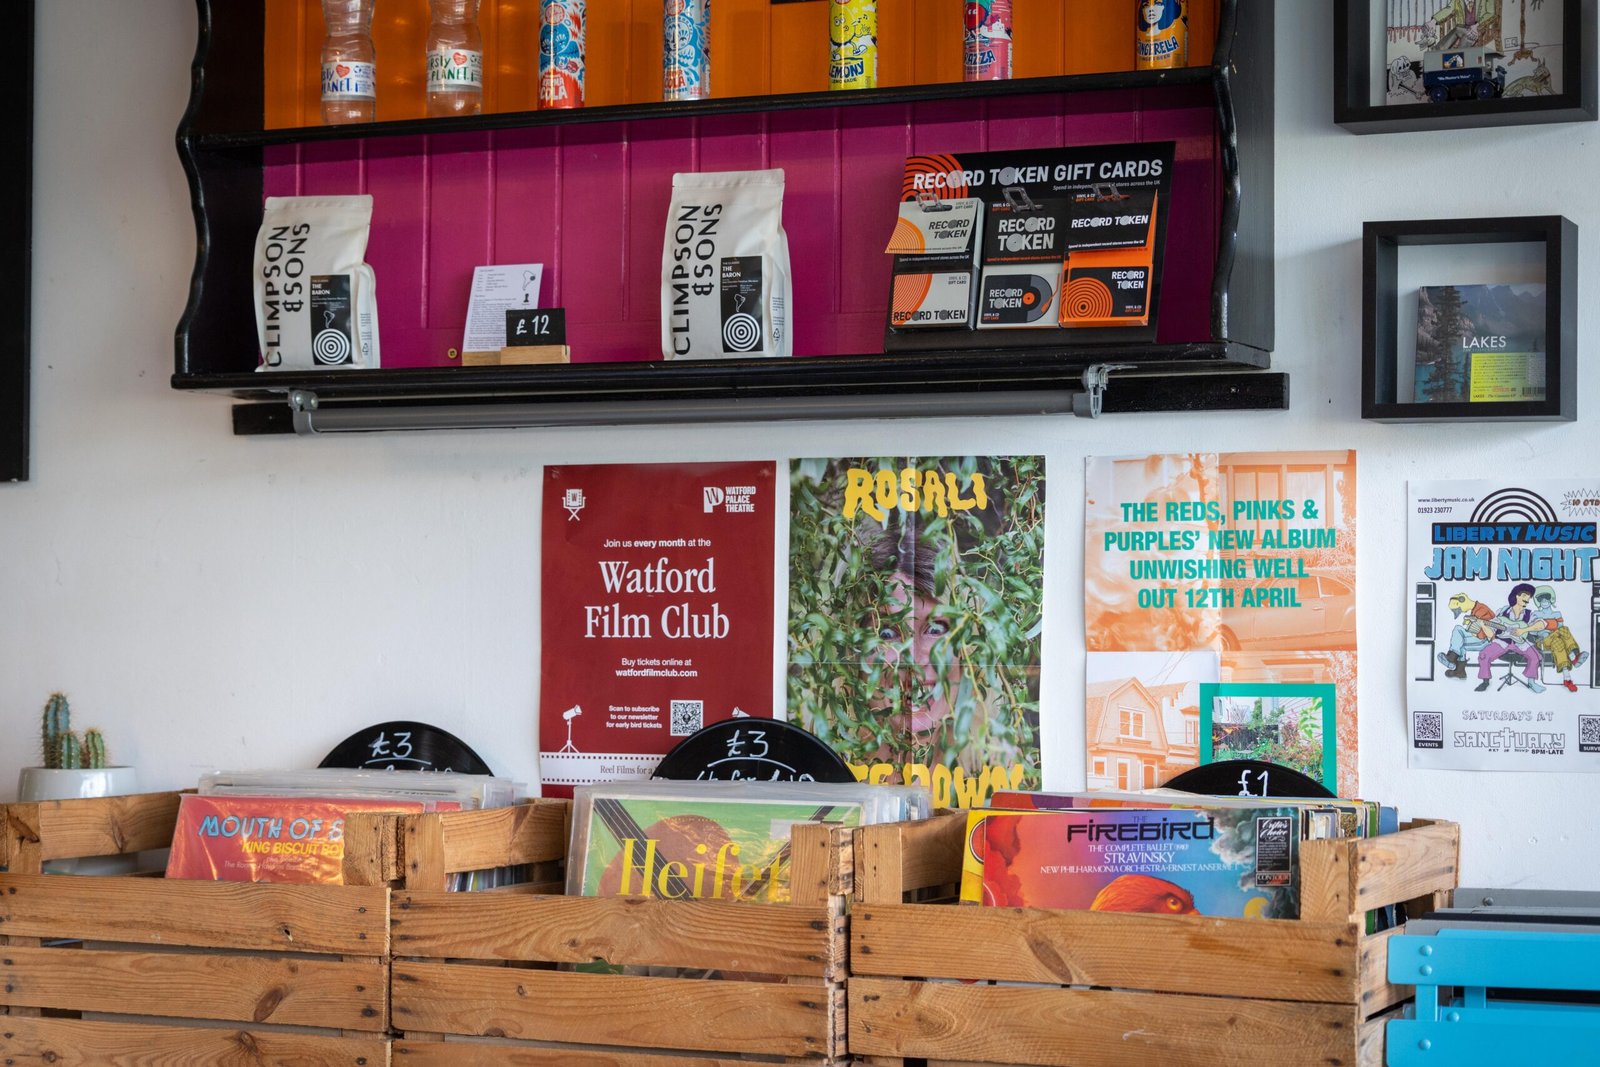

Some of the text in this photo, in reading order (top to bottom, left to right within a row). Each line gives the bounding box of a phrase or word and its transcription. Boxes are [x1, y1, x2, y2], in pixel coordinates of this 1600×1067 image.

[913, 159, 1163, 190] RECORD TOKEN GIFT CARDS
[928, 219, 970, 230] RECORD
[998, 217, 1055, 232] RECORD
[1071, 215, 1149, 228] RECORD TOKEN
[694, 204, 722, 277] SONS
[934, 230, 967, 239] TOKEN
[998, 233, 1054, 252] TOKEN
[284, 223, 310, 295] SONS
[672, 206, 701, 355] CLIMPSON
[1112, 270, 1145, 280] RECORD
[1117, 280, 1144, 289] TOKEN
[263, 226, 290, 367] CLIMPSON
[989, 288, 1023, 297] RECORD
[989, 298, 1022, 309] TOKEN
[894, 309, 966, 321] RECORD TOKEN
[1462, 336, 1507, 349] LAKES
[725, 486, 756, 495] WATFORD
[842, 467, 988, 522] ROSALI
[725, 495, 750, 504] PALACE
[725, 504, 755, 513] THEATRE
[1120, 499, 1319, 525] THE REDS, PINKS &
[1208, 529, 1257, 550] NEW
[1262, 528, 1336, 549] ALBUM
[1434, 524, 1595, 542] LIBERTY MUSIC
[604, 539, 620, 548] Join
[634, 540, 657, 549] every
[659, 538, 686, 547] month
[688, 538, 696, 547] at
[698, 538, 711, 546] the
[1129, 558, 1309, 580] UNWISHING WELL
[1424, 546, 1600, 583] JAM NIGHT
[598, 557, 716, 593] Watford
[1138, 587, 1302, 609] OUT 12TH APRIL
[584, 602, 730, 639] Film Club
[621, 657, 692, 667] Buy tickets online at
[615, 668, 698, 677] watfordfilmclub.com
[1462, 710, 1554, 721] SATURDAYS AT
[726, 730, 769, 757] £3
[1454, 727, 1565, 749] SANCTUARY
[600, 765, 614, 774] Reel
[616, 765, 635, 774] Films
[636, 765, 647, 774] for
[1237, 770, 1269, 797] £1
[1132, 815, 1148, 823] THE
[198, 815, 283, 839] MOUTH
[289, 818, 323, 840] OF
[242, 841, 270, 854] KING
[272, 842, 318, 855] BISCUIT
[1088, 844, 1105, 852] THE
[1105, 844, 1146, 852] COMPLETE
[1147, 843, 1173, 851] BALLET
[1104, 852, 1176, 864] STRAVINSKY
[1040, 865, 1060, 874] NEW
[1060, 865, 1119, 873] PHILHARMONIA
